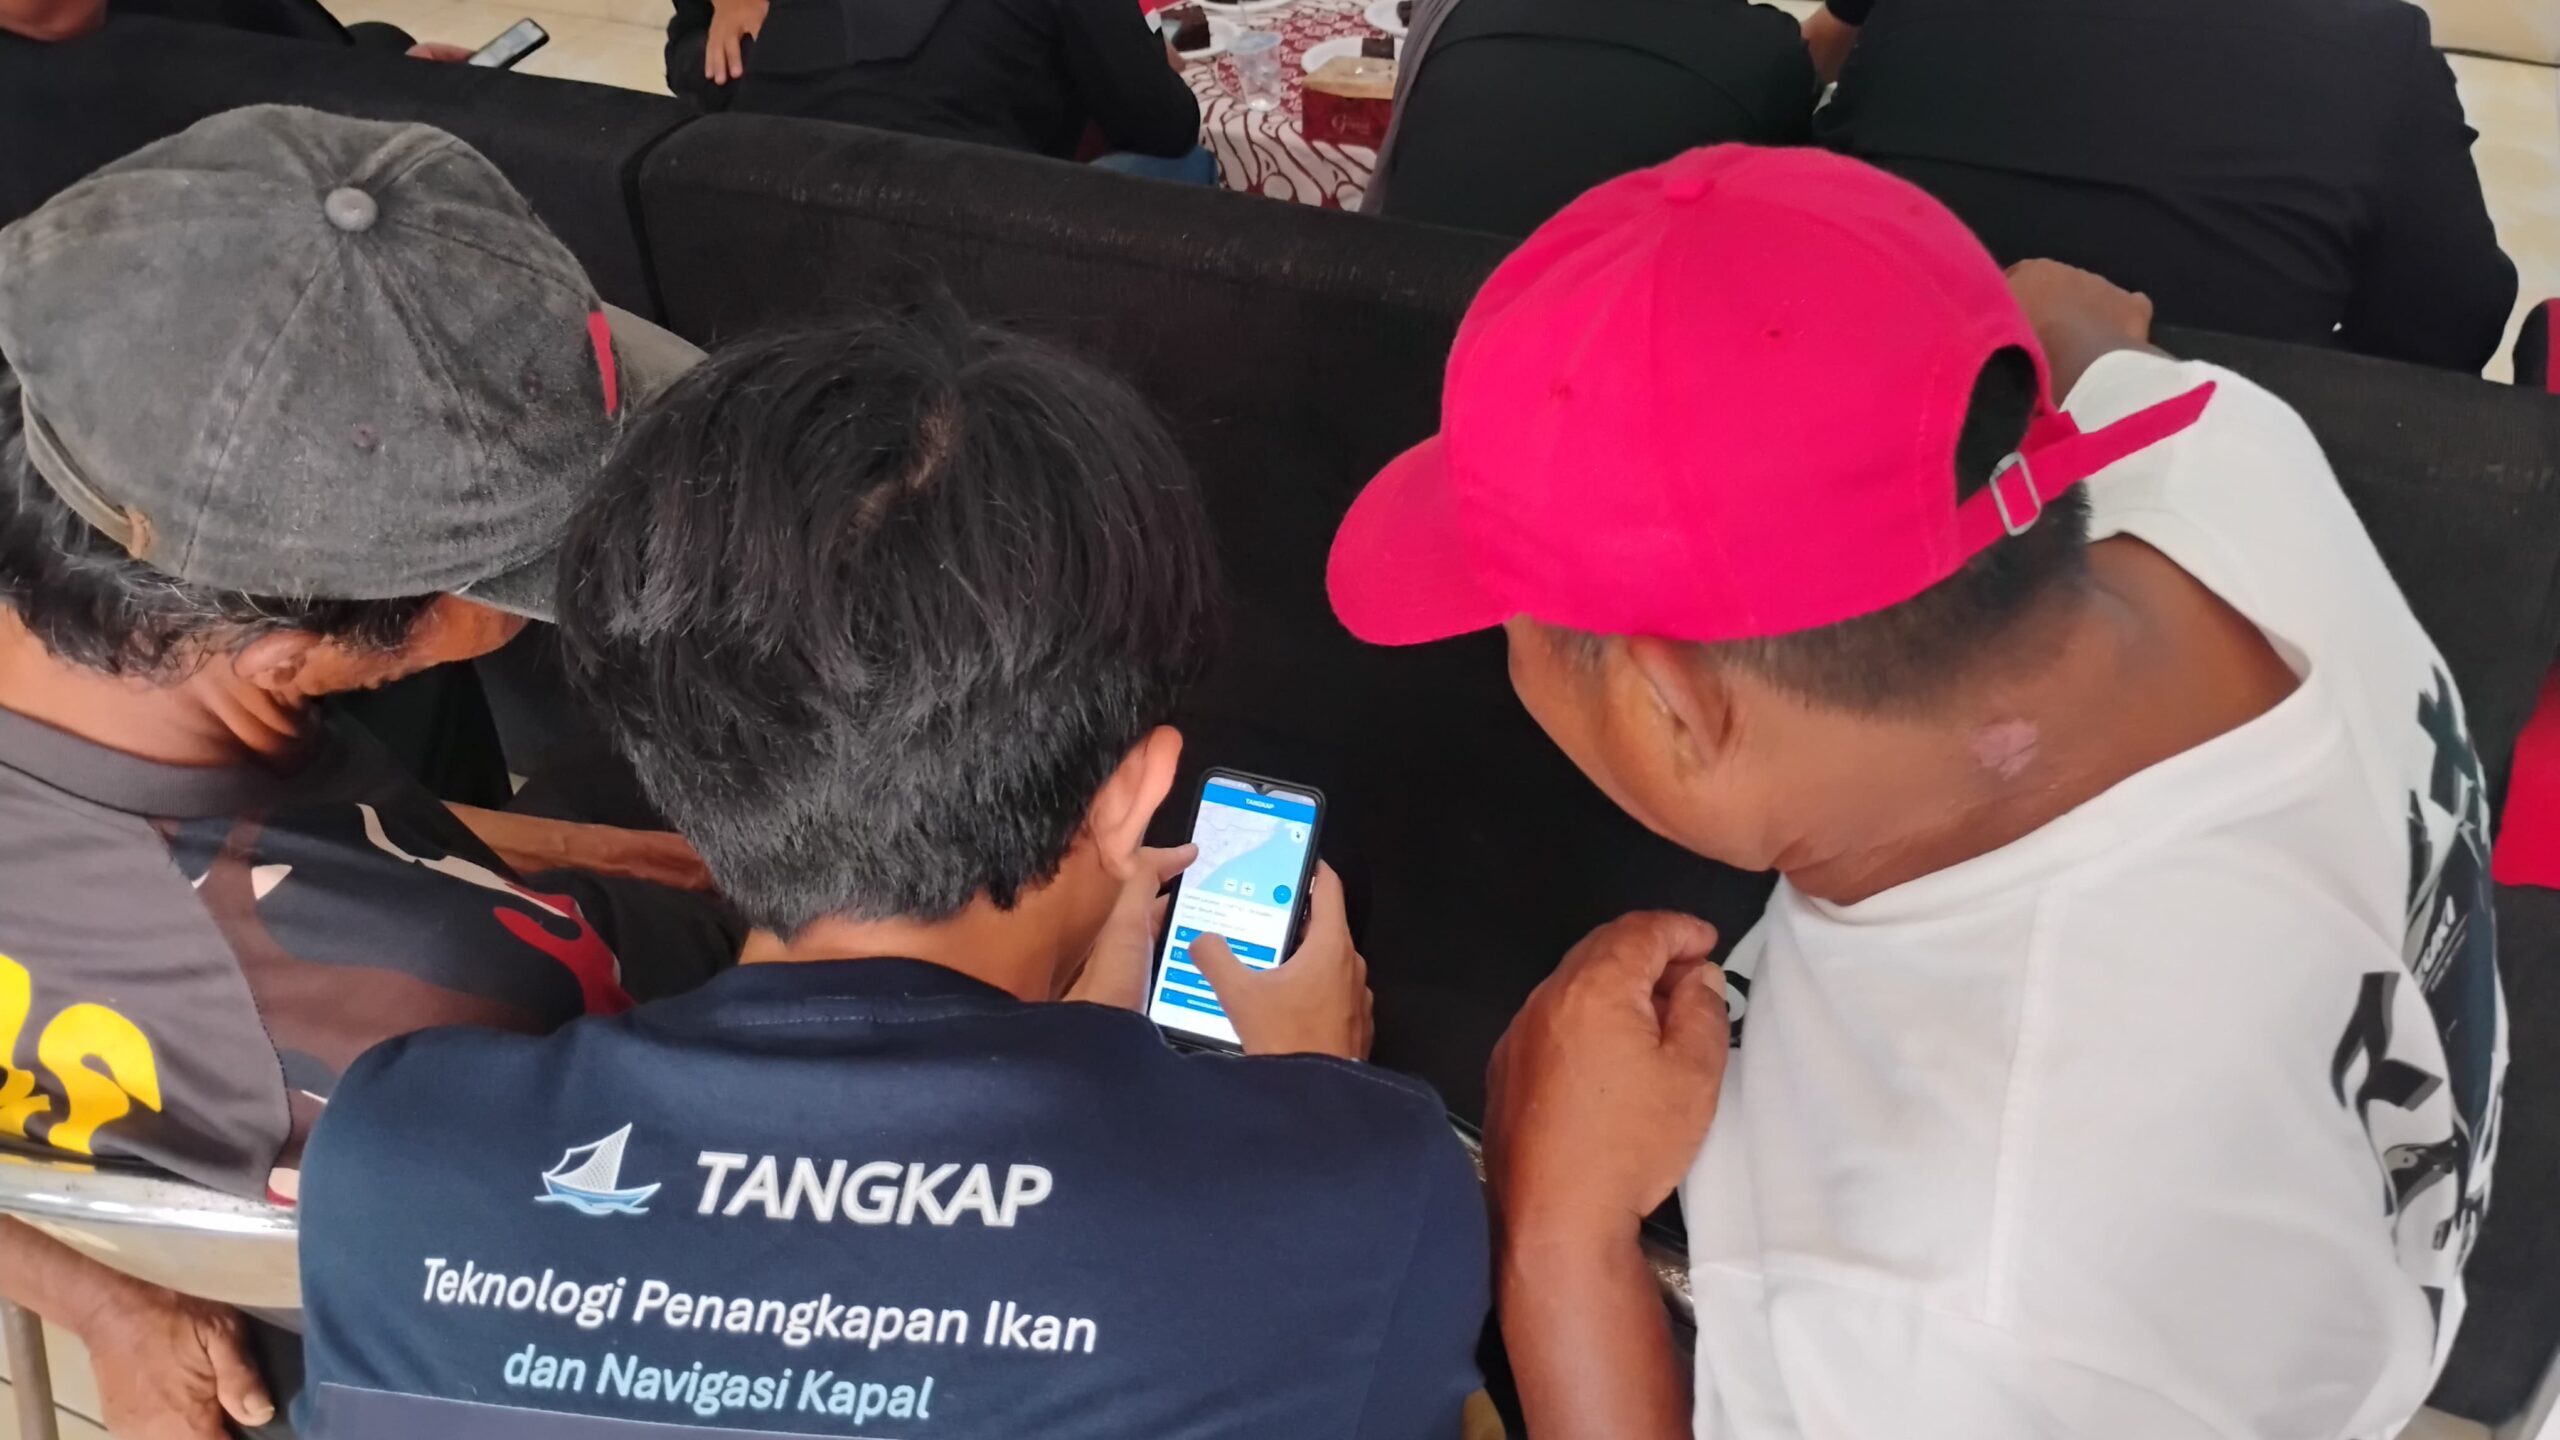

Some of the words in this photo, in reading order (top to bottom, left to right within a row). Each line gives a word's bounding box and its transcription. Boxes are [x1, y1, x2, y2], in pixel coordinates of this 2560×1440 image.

[697, 1151, 1052, 1228] TANGKAP
[423, 1258, 625, 1328] Teknologi
[633, 1279, 969, 1348] Penangkapan
[983, 1300, 1097, 1353] Ikan
[504, 1344, 586, 1392] dan
[597, 1354, 792, 1415] Navigasi
[798, 1370, 934, 1425] Kapal
